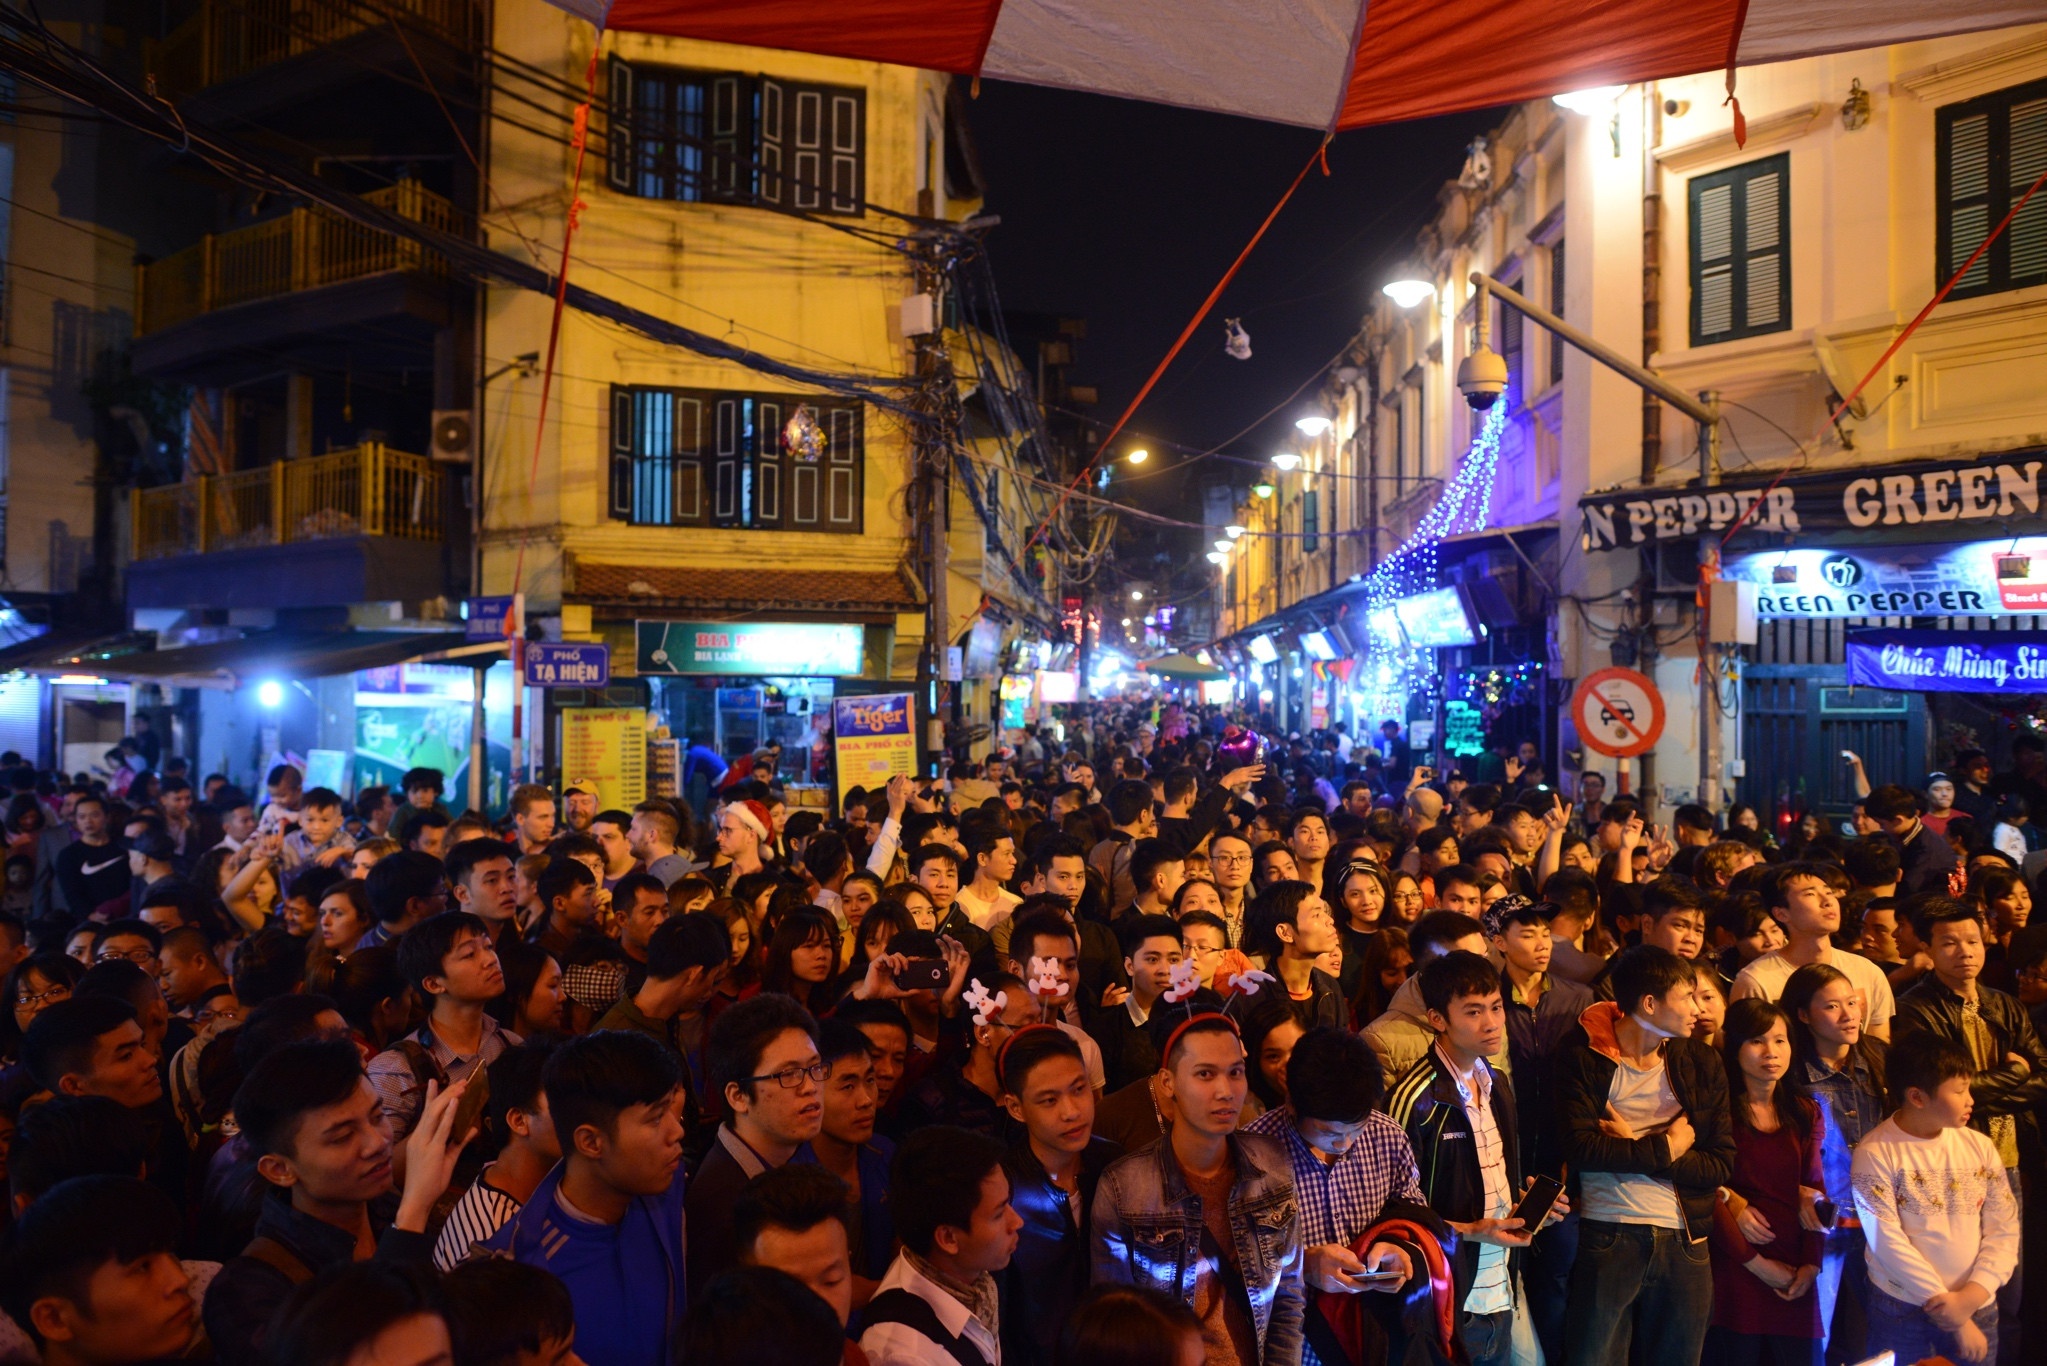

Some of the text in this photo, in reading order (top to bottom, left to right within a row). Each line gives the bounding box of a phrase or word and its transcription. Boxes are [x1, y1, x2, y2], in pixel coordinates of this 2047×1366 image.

[1625, 486, 1801, 543] PEPPER
[1843, 461, 2042, 527] GREEN
[1847, 590, 1985, 613] PEPPER
[695, 632, 730, 648] BIA
[552, 647, 581, 661] PHỐ
[1880, 643, 1935, 676] Chúc
[1938, 645, 2011, 687] Mừng
[535, 661, 599, 684] TẠ HIỆN
[851, 704, 904, 732] Tiger
[838, 742, 862, 751] BIA
[865, 738, 892, 750] PHỐ
